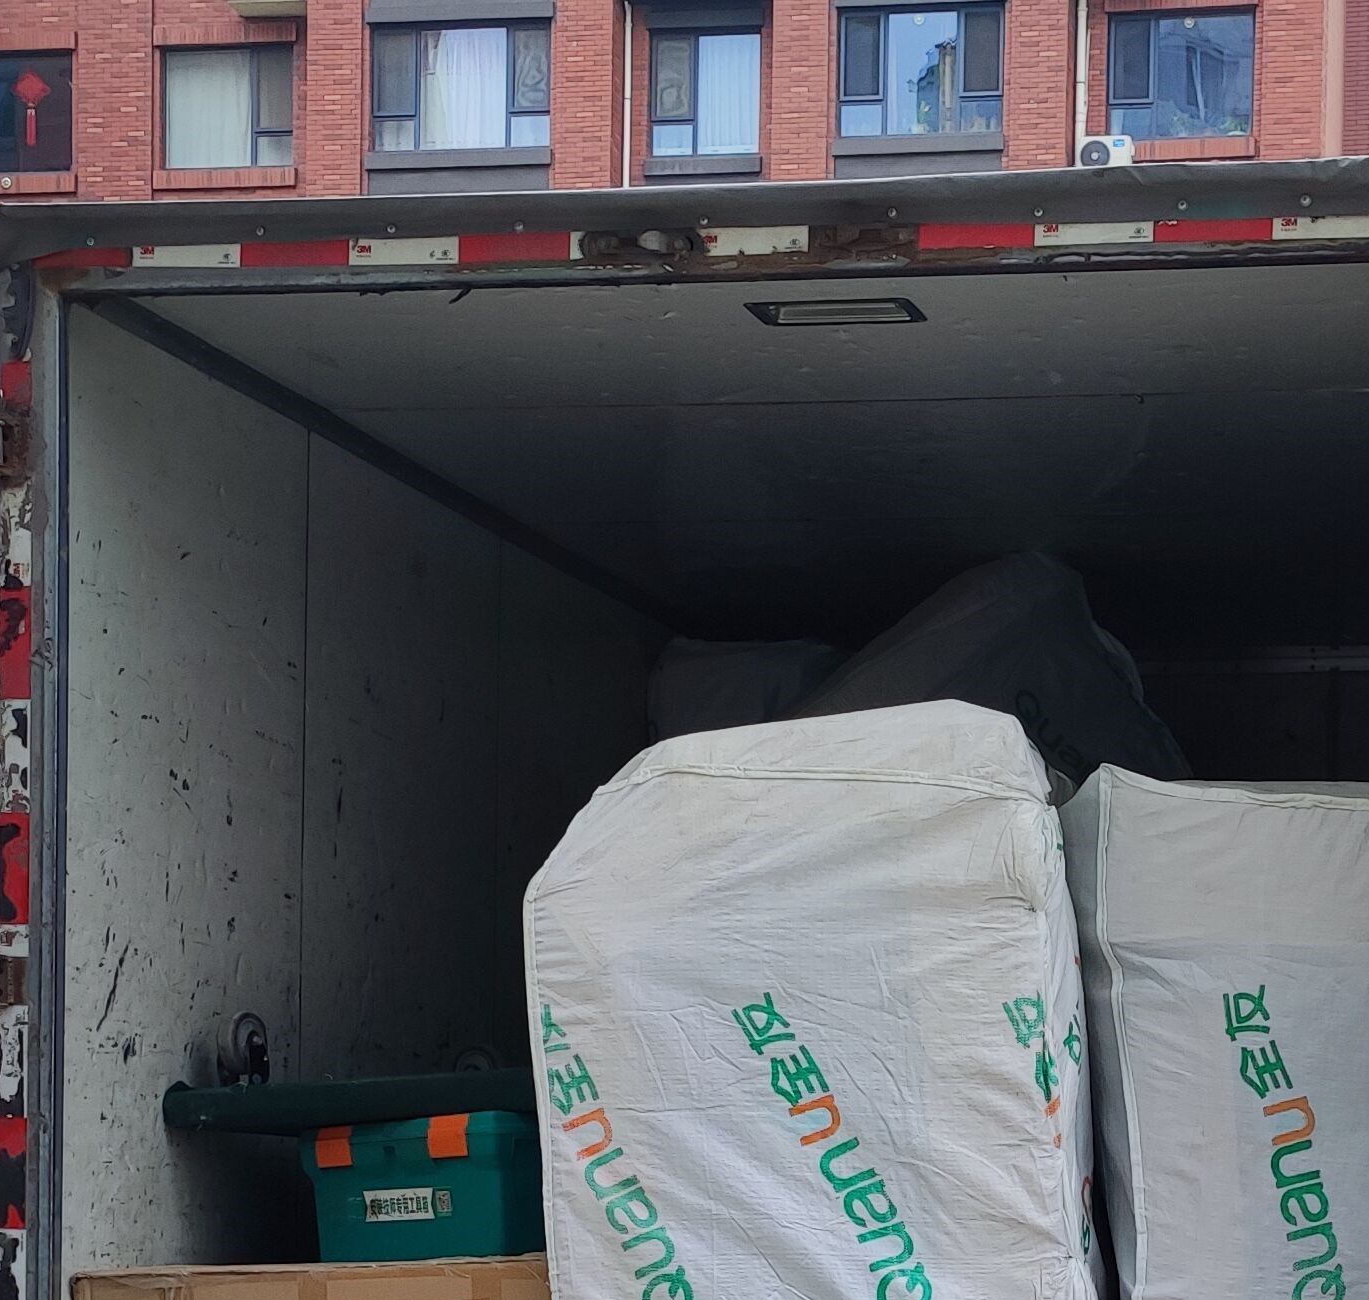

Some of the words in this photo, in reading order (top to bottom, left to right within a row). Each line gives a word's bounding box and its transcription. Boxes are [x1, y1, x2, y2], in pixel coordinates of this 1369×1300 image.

[1281, 218, 1297, 227] 3M
[1043, 224, 1059, 233] 3M
[140, 246, 155, 256] 3M
[356, 245, 372, 254] 3M
